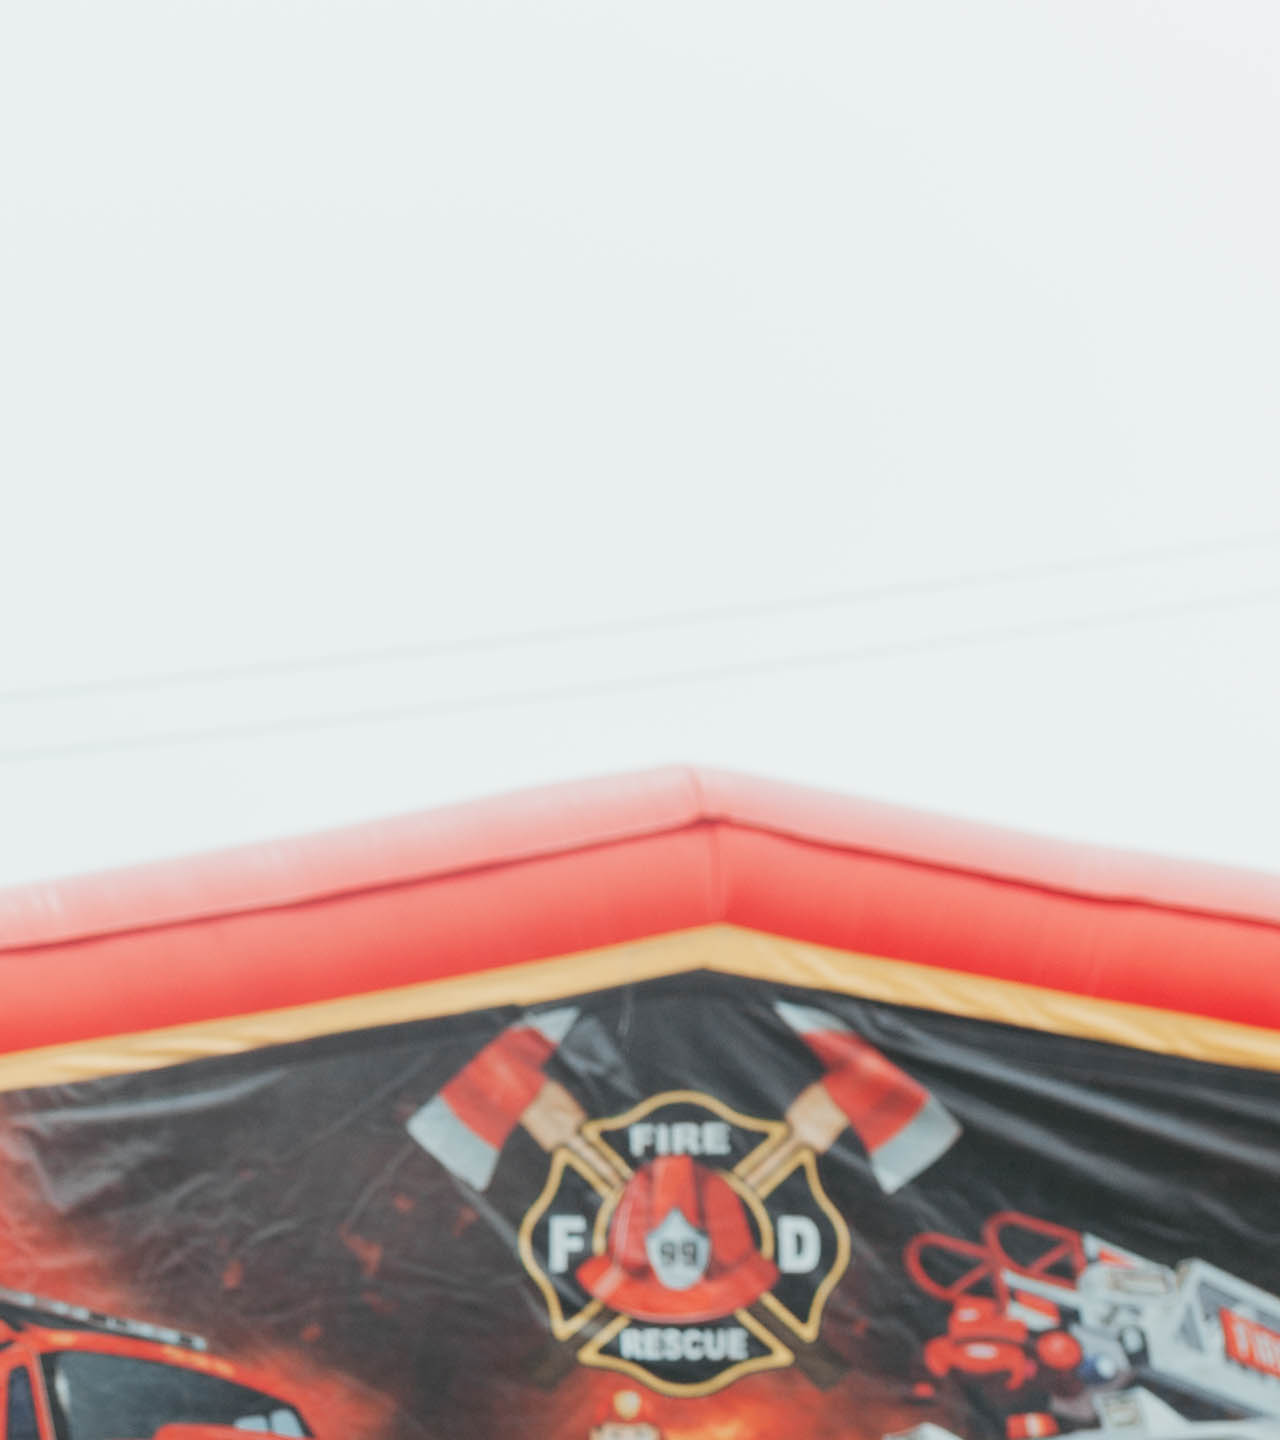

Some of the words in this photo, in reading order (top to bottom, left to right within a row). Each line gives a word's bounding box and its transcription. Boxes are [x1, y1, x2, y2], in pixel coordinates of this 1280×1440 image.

[628, 1121, 732, 1157] FIRE
[547, 1214, 588, 1275] F
[659, 1242, 698, 1266] 99
[777, 1214, 822, 1274] D
[619, 1327, 750, 1361] RESCUE
